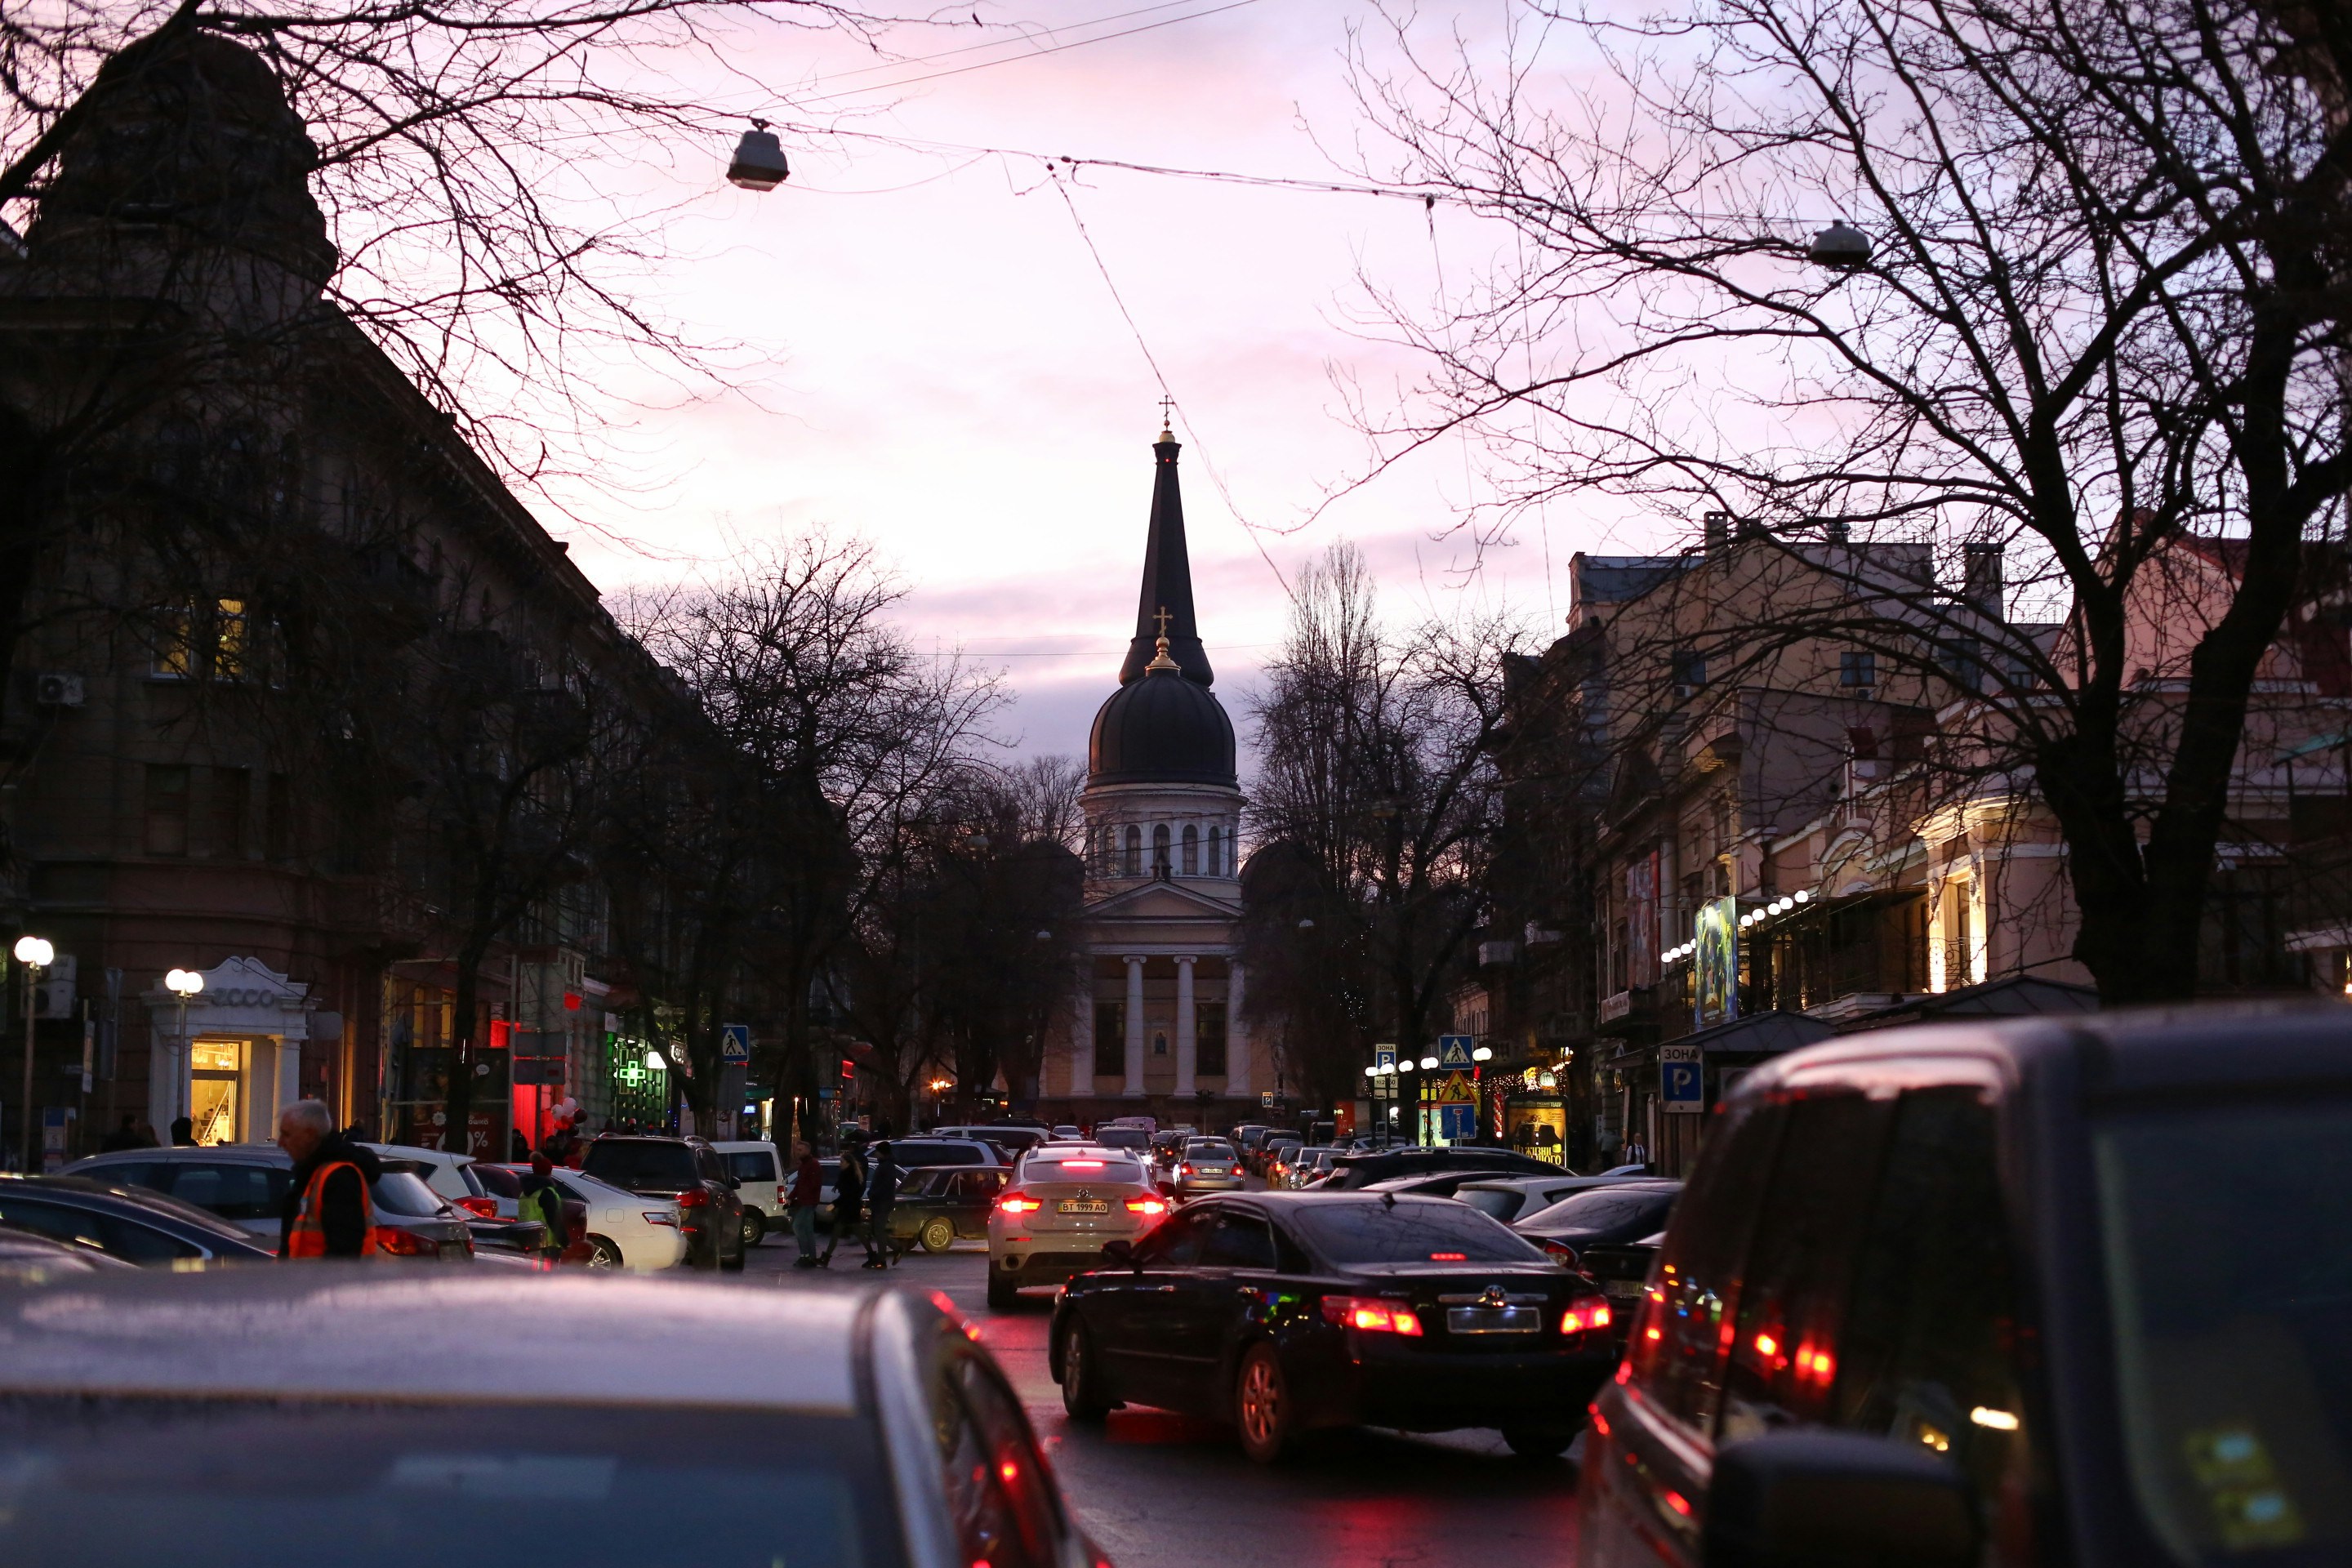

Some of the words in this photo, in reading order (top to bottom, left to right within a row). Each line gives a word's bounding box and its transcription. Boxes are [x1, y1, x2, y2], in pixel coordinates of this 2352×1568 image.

[1664, 1049, 1698, 1060] ЗОНА
[1673, 1068, 1692, 1095] P
[1062, 1203, 1075, 1211] BT
[1076, 1203, 1093, 1211] 1999
